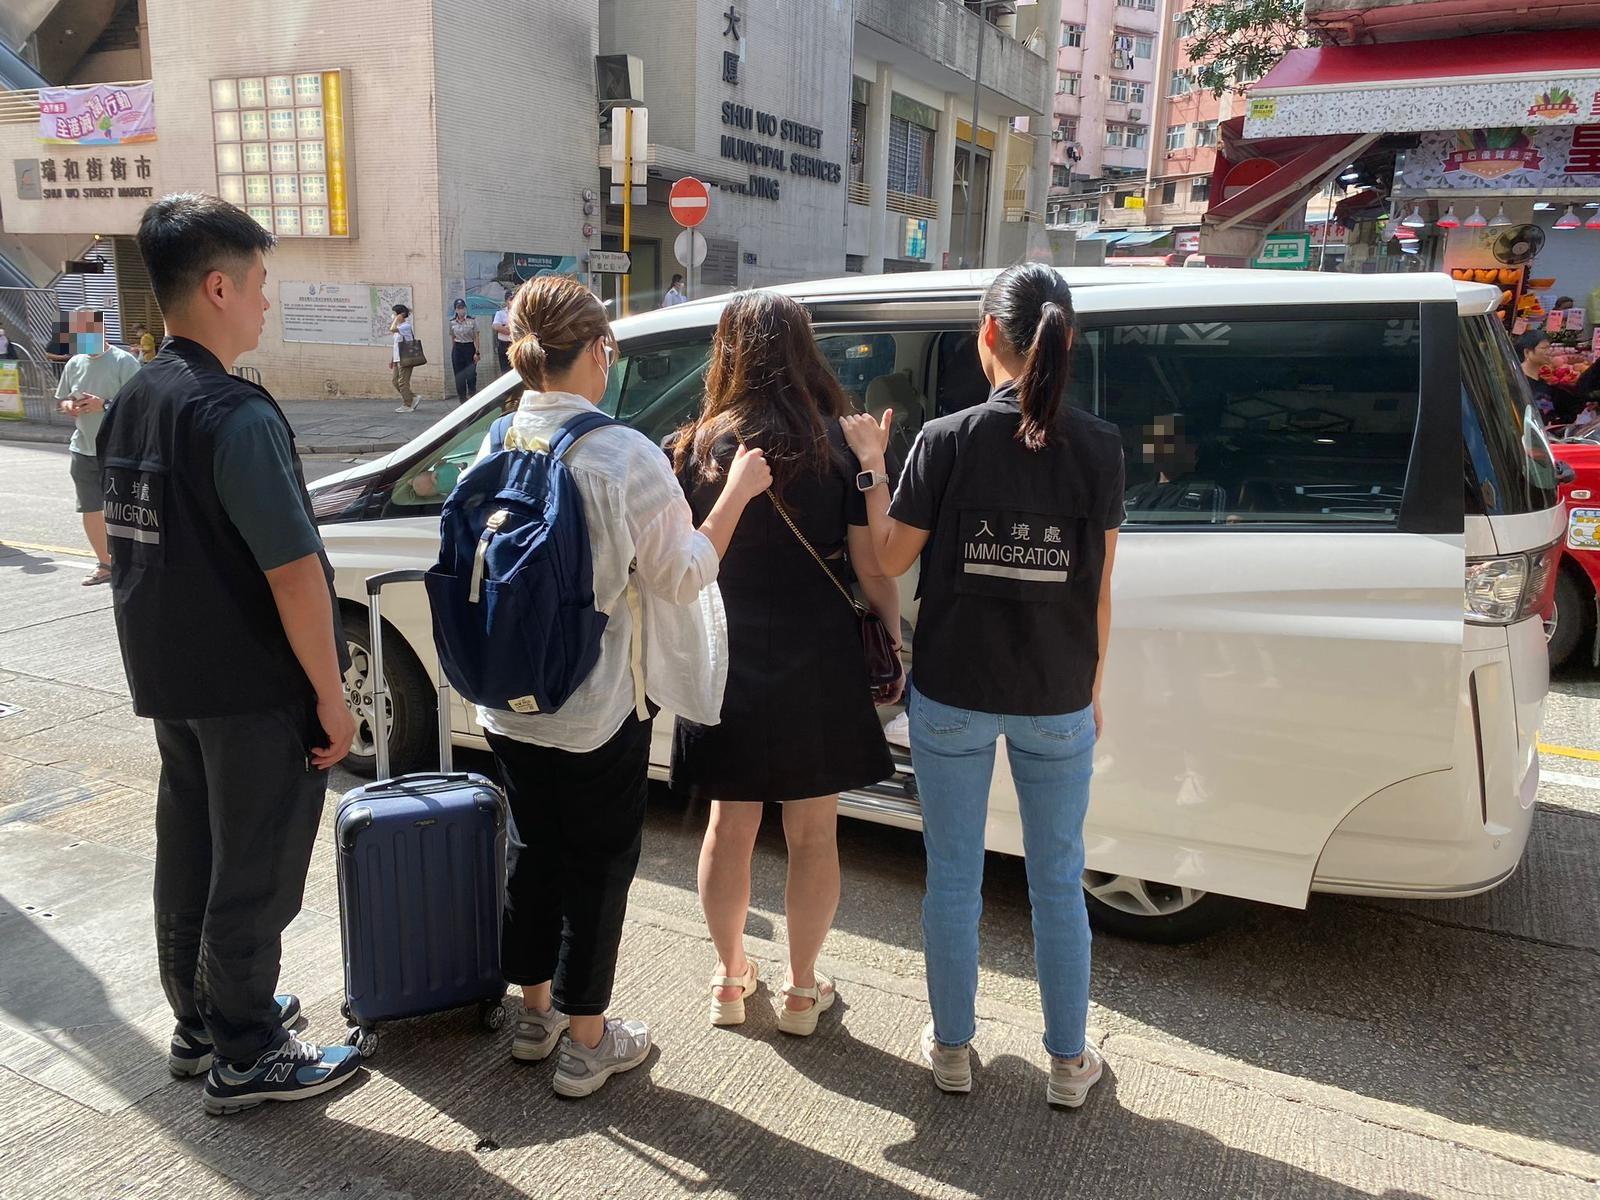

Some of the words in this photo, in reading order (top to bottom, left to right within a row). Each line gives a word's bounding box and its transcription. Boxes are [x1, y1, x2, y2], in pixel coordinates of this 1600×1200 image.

[722, 5, 741, 86] 大廈
[721, 101, 754, 131] SHUI
[756, 111, 778, 137] WO
[780, 118, 823, 149] STREET
[40, 154, 152, 182] 瑞和街街市
[720, 134, 787, 171] MUNICIPAL
[790, 152, 841, 184] SERVICES
[43, 188, 62, 199] SHUI
[65, 188, 79, 199] WO
[83, 187, 114, 198] STREET
[118, 186, 153, 198] MARKET
[975, 520, 1062, 543] 入境處
[964, 542, 1070, 567] IMMIGRATION
[264, 1062, 294, 1083] N
